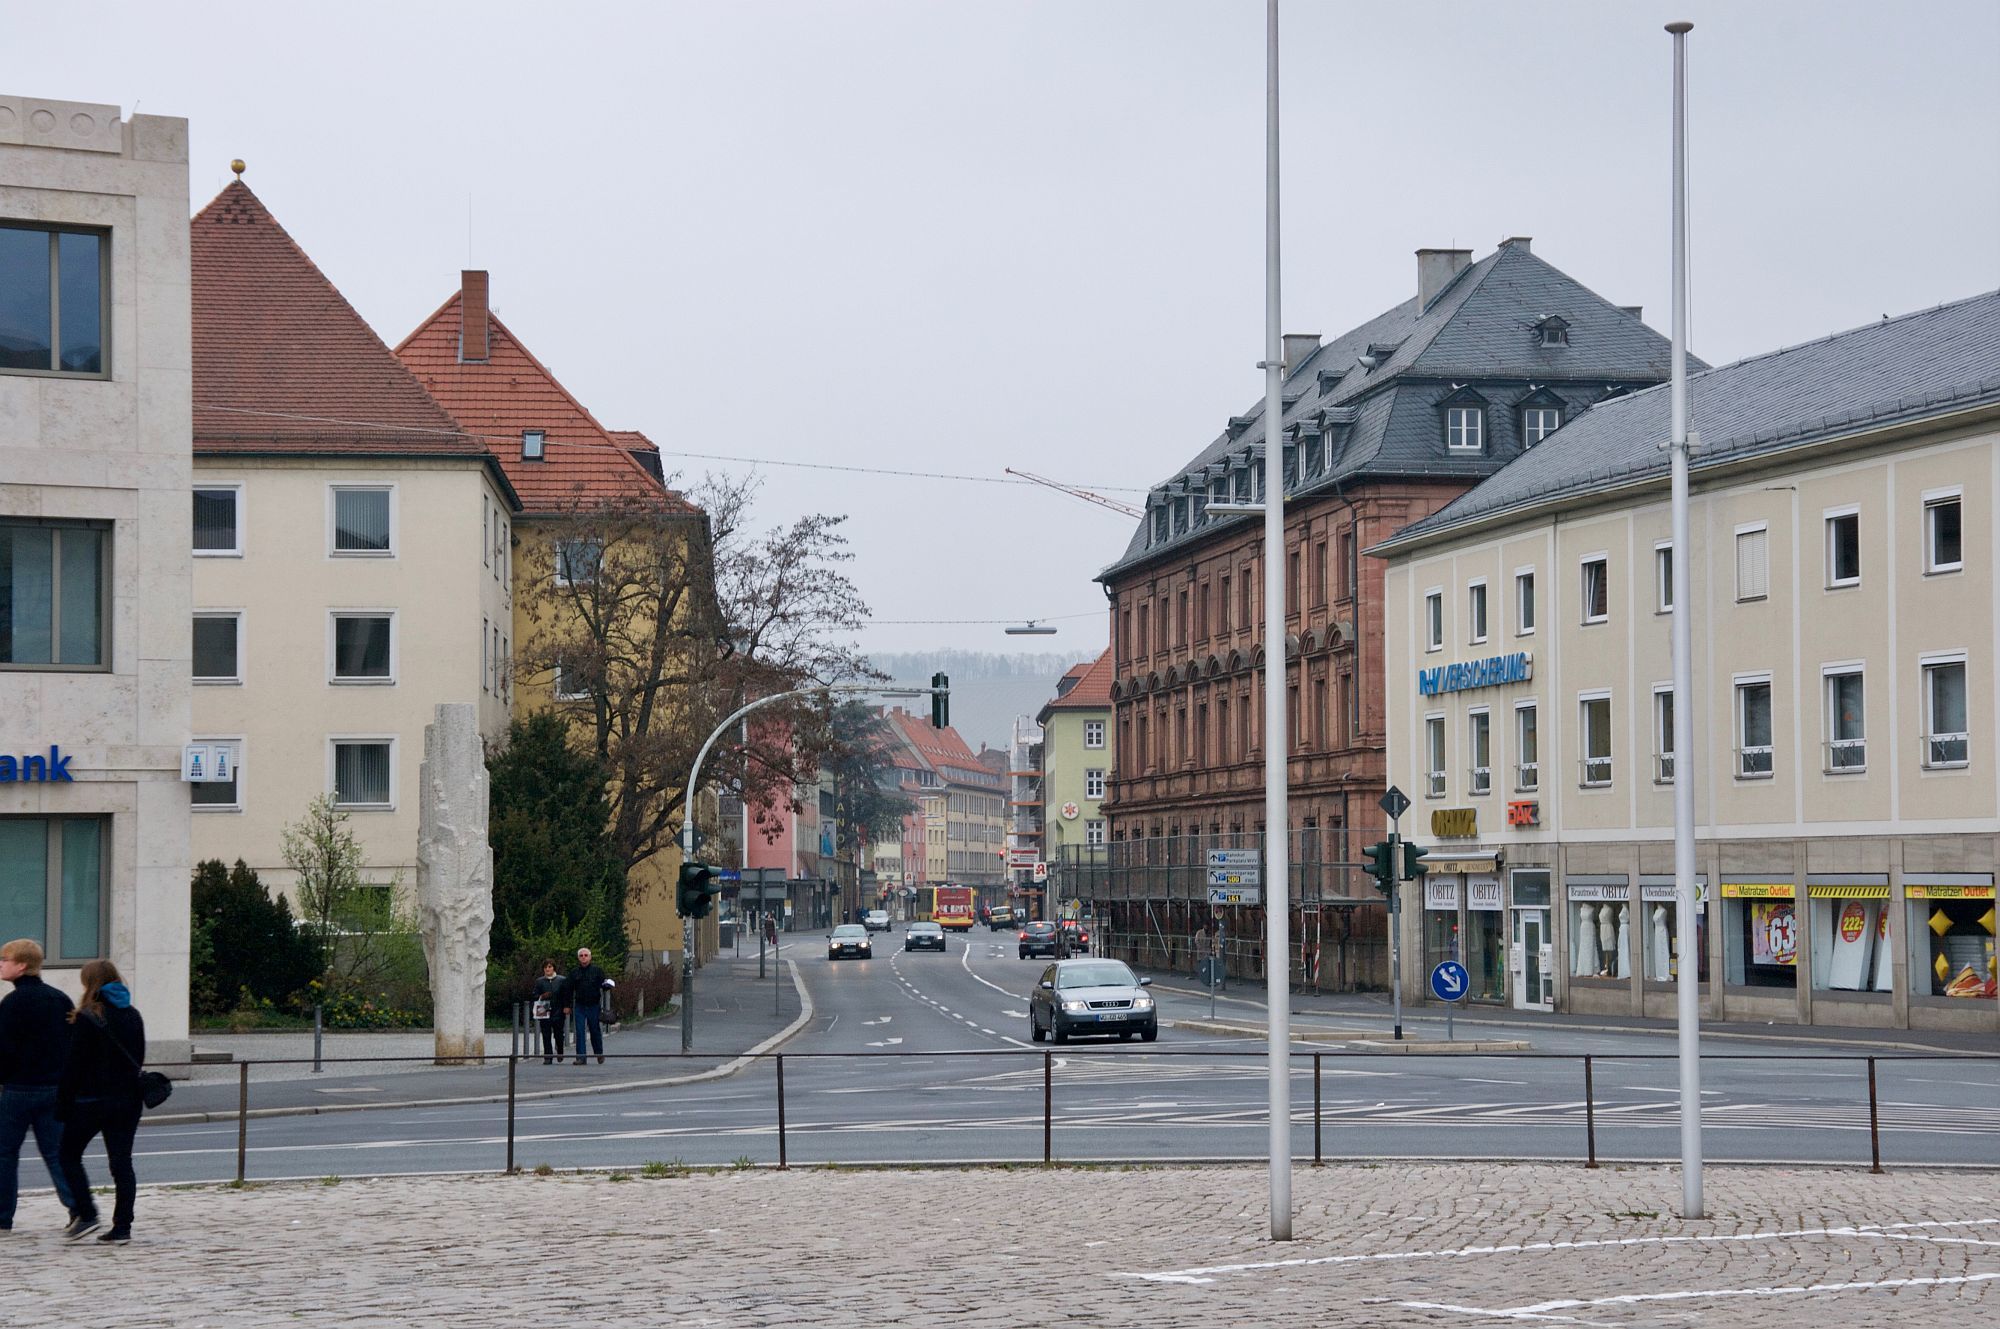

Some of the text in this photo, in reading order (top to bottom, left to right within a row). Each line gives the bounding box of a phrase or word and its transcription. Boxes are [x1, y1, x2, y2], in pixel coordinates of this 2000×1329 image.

[1443, 651, 1528, 691] VERSICHERUNG
[0, 745, 74, 783] ank
[1508, 801, 1537, 825] DAK
[1443, 863, 1458, 872] OBITZ
[1432, 884, 1455, 900] OBITZ
[1472, 883, 1497, 900] OBITZ
[1570, 885, 1629, 899] Brautmode OBITZ
[1644, 887, 1676, 897] Abendmode
[1739, 886, 1769, 896] Matratzen
[1769, 886, 1791, 896] Outlet
[1926, 886, 1962, 897] Matratzen
[1963, 886, 1989, 897] Outlet
